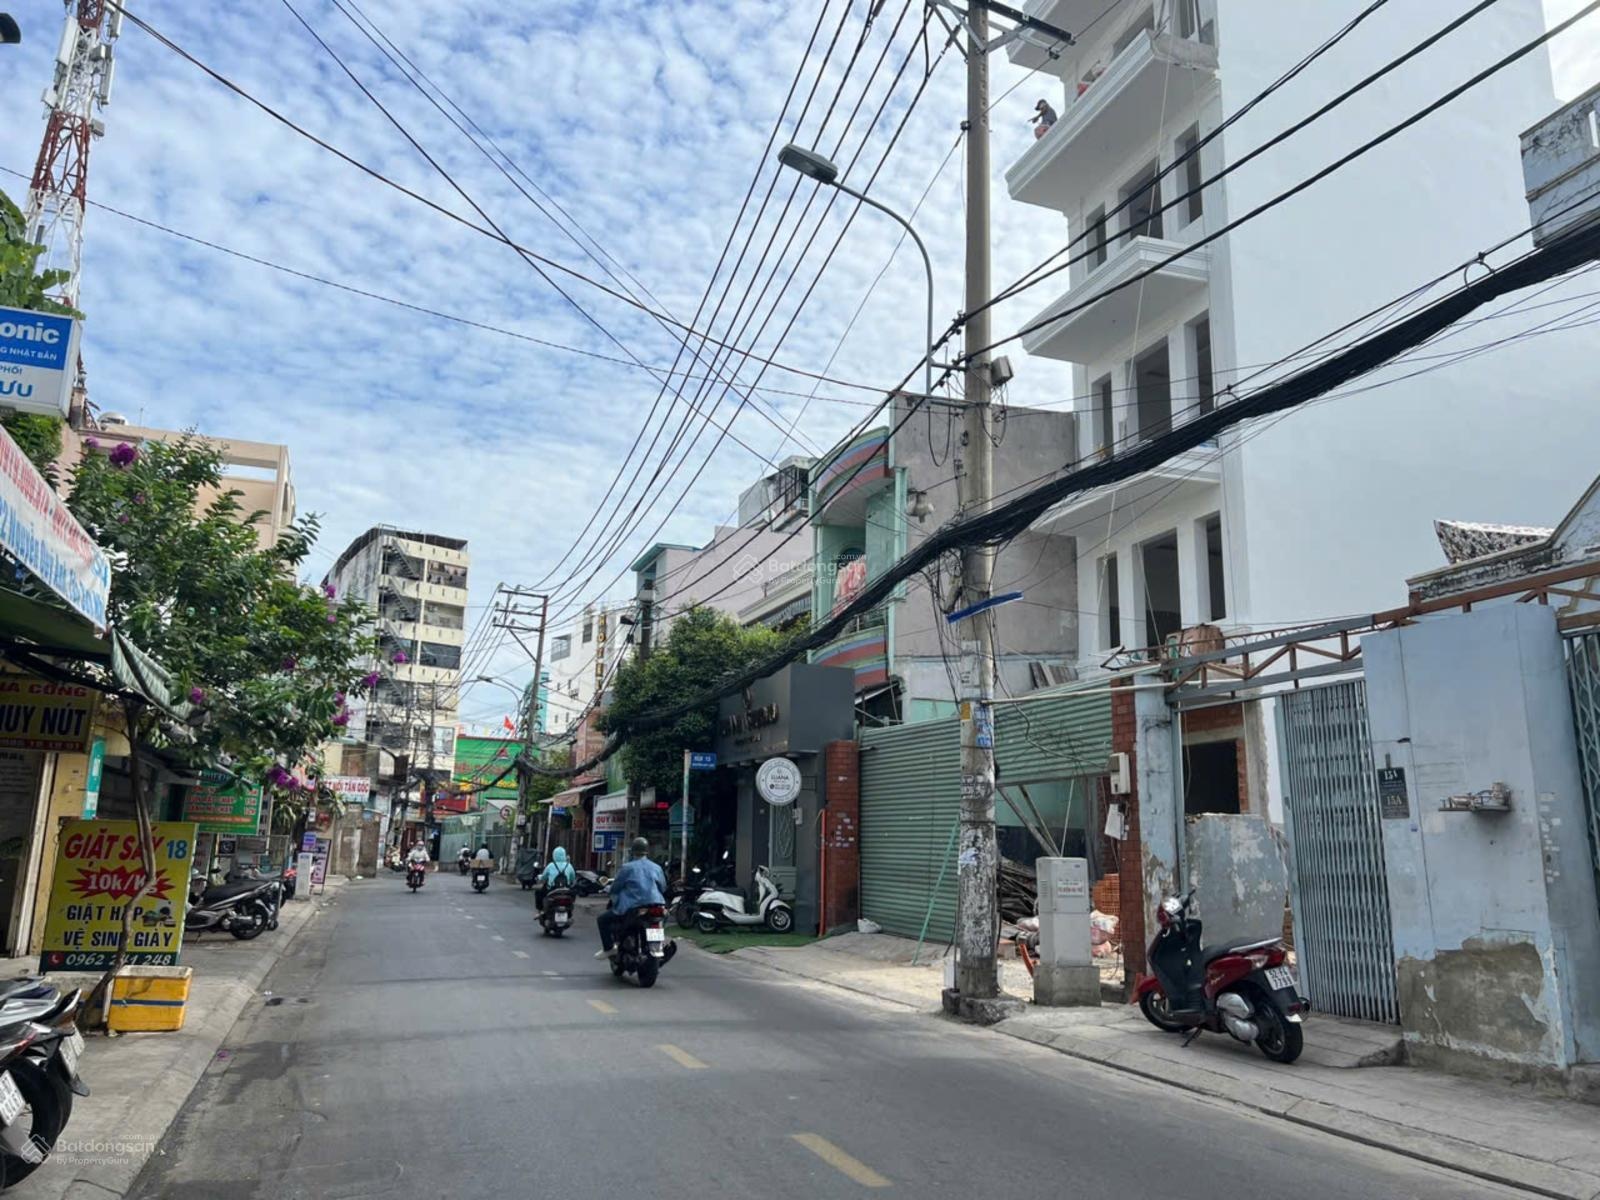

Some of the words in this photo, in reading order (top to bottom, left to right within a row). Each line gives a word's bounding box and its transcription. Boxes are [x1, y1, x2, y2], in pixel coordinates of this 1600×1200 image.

[0, 321, 60, 345] onic
[40, 702, 87, 737] NÚT
[64, 828, 119, 867] GIẶT
[166, 839, 188, 859] 18
[109, 906, 144, 921] HP
[63, 928, 85, 950] VỆ
[90, 931, 125, 947] SIN
[66, 953, 105, 966] 0962
[141, 954, 172, 967] 248
